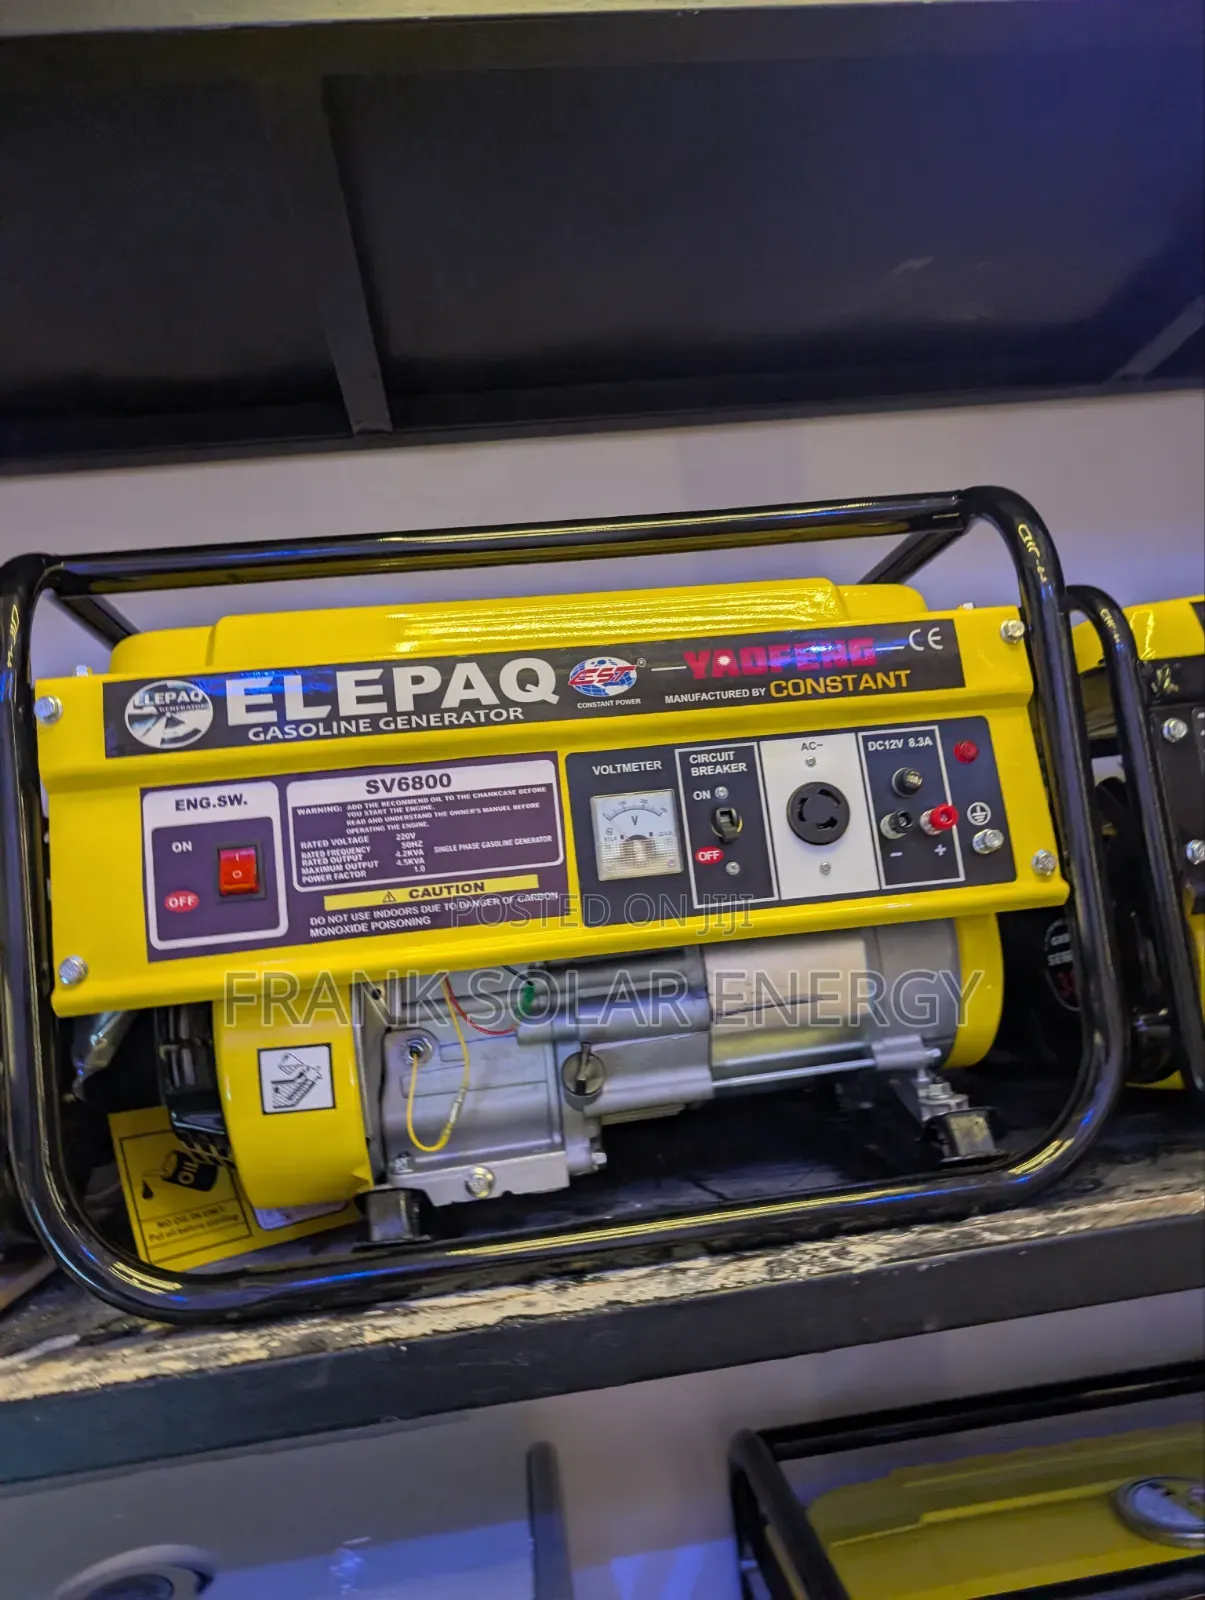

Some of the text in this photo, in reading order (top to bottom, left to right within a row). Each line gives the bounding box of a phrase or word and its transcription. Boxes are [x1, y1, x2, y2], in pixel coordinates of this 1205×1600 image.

[909, 627, 943, 651] CE
[225, 657, 560, 726] ELEPAQ
[665, 670, 911, 704] MANUFACTURED BY CONSTANT
[577, 698, 641, 709] CONSTANT POWER
[248, 707, 525, 742] GASOLINE GENERATOR
[867, 736, 933, 751] DC12V 8.3A
[689, 751, 735, 764] CIRCUIT
[592, 760, 662, 775] VOLTMETER
[691, 762, 747, 777] BREAKER
[366, 773, 452, 795] SV6800
[175, 793, 248, 811] ENG.SW.
[297, 805, 342, 816] WARNING:
[364, 801, 380, 809] THE
[381, 797, 429, 807] RECOMMEND
[518, 786, 547, 795] BEFORE
[693, 790, 711, 801] ON
[384, 813, 432, 823] UNDERSTAND
[450, 808, 481, 816] OWNER'S
[513, 802, 540, 810] BEFORE
[389, 806, 404, 814] THE
[631, 815, 638, 826] V
[345, 825, 385, 835] OPERATING
[387, 823, 400, 831] THE
[172, 840, 193, 853] ON
[300, 832, 416, 849] RATED VOLTAGE 220V
[433, 835, 553, 854] SINGLE PHASE GASOLINE GENERATOR
[301, 849, 326, 859] RATED
[327, 846, 371, 857] FREQUENCY
[697, 850, 720, 861] OFF
[301, 857, 329, 867] RATED
[330, 854, 363, 864] OUTPUT
[301, 864, 343, 875] MAXIMUM
[344, 860, 379, 870] OUTPUT
[301, 873, 332, 883] POWER
[334, 870, 367, 880] FACTOR
[409, 882, 485, 899] CAUTION
[168, 895, 195, 908] OFF
[310, 916, 326, 926] DO
[327, 914, 349, 924] NOT
[350, 911, 371, 921] USE
[373, 906, 419, 918] INDOORS
[420, 903, 441, 913] DUE
[444, 902, 457, 911] TO
[458, 898, 501, 909] DANGER
[502, 896, 514, 905] OF
[310, 916, 431, 938] MONOXIDE POISONING
[177, 1161, 199, 1186] OIL
